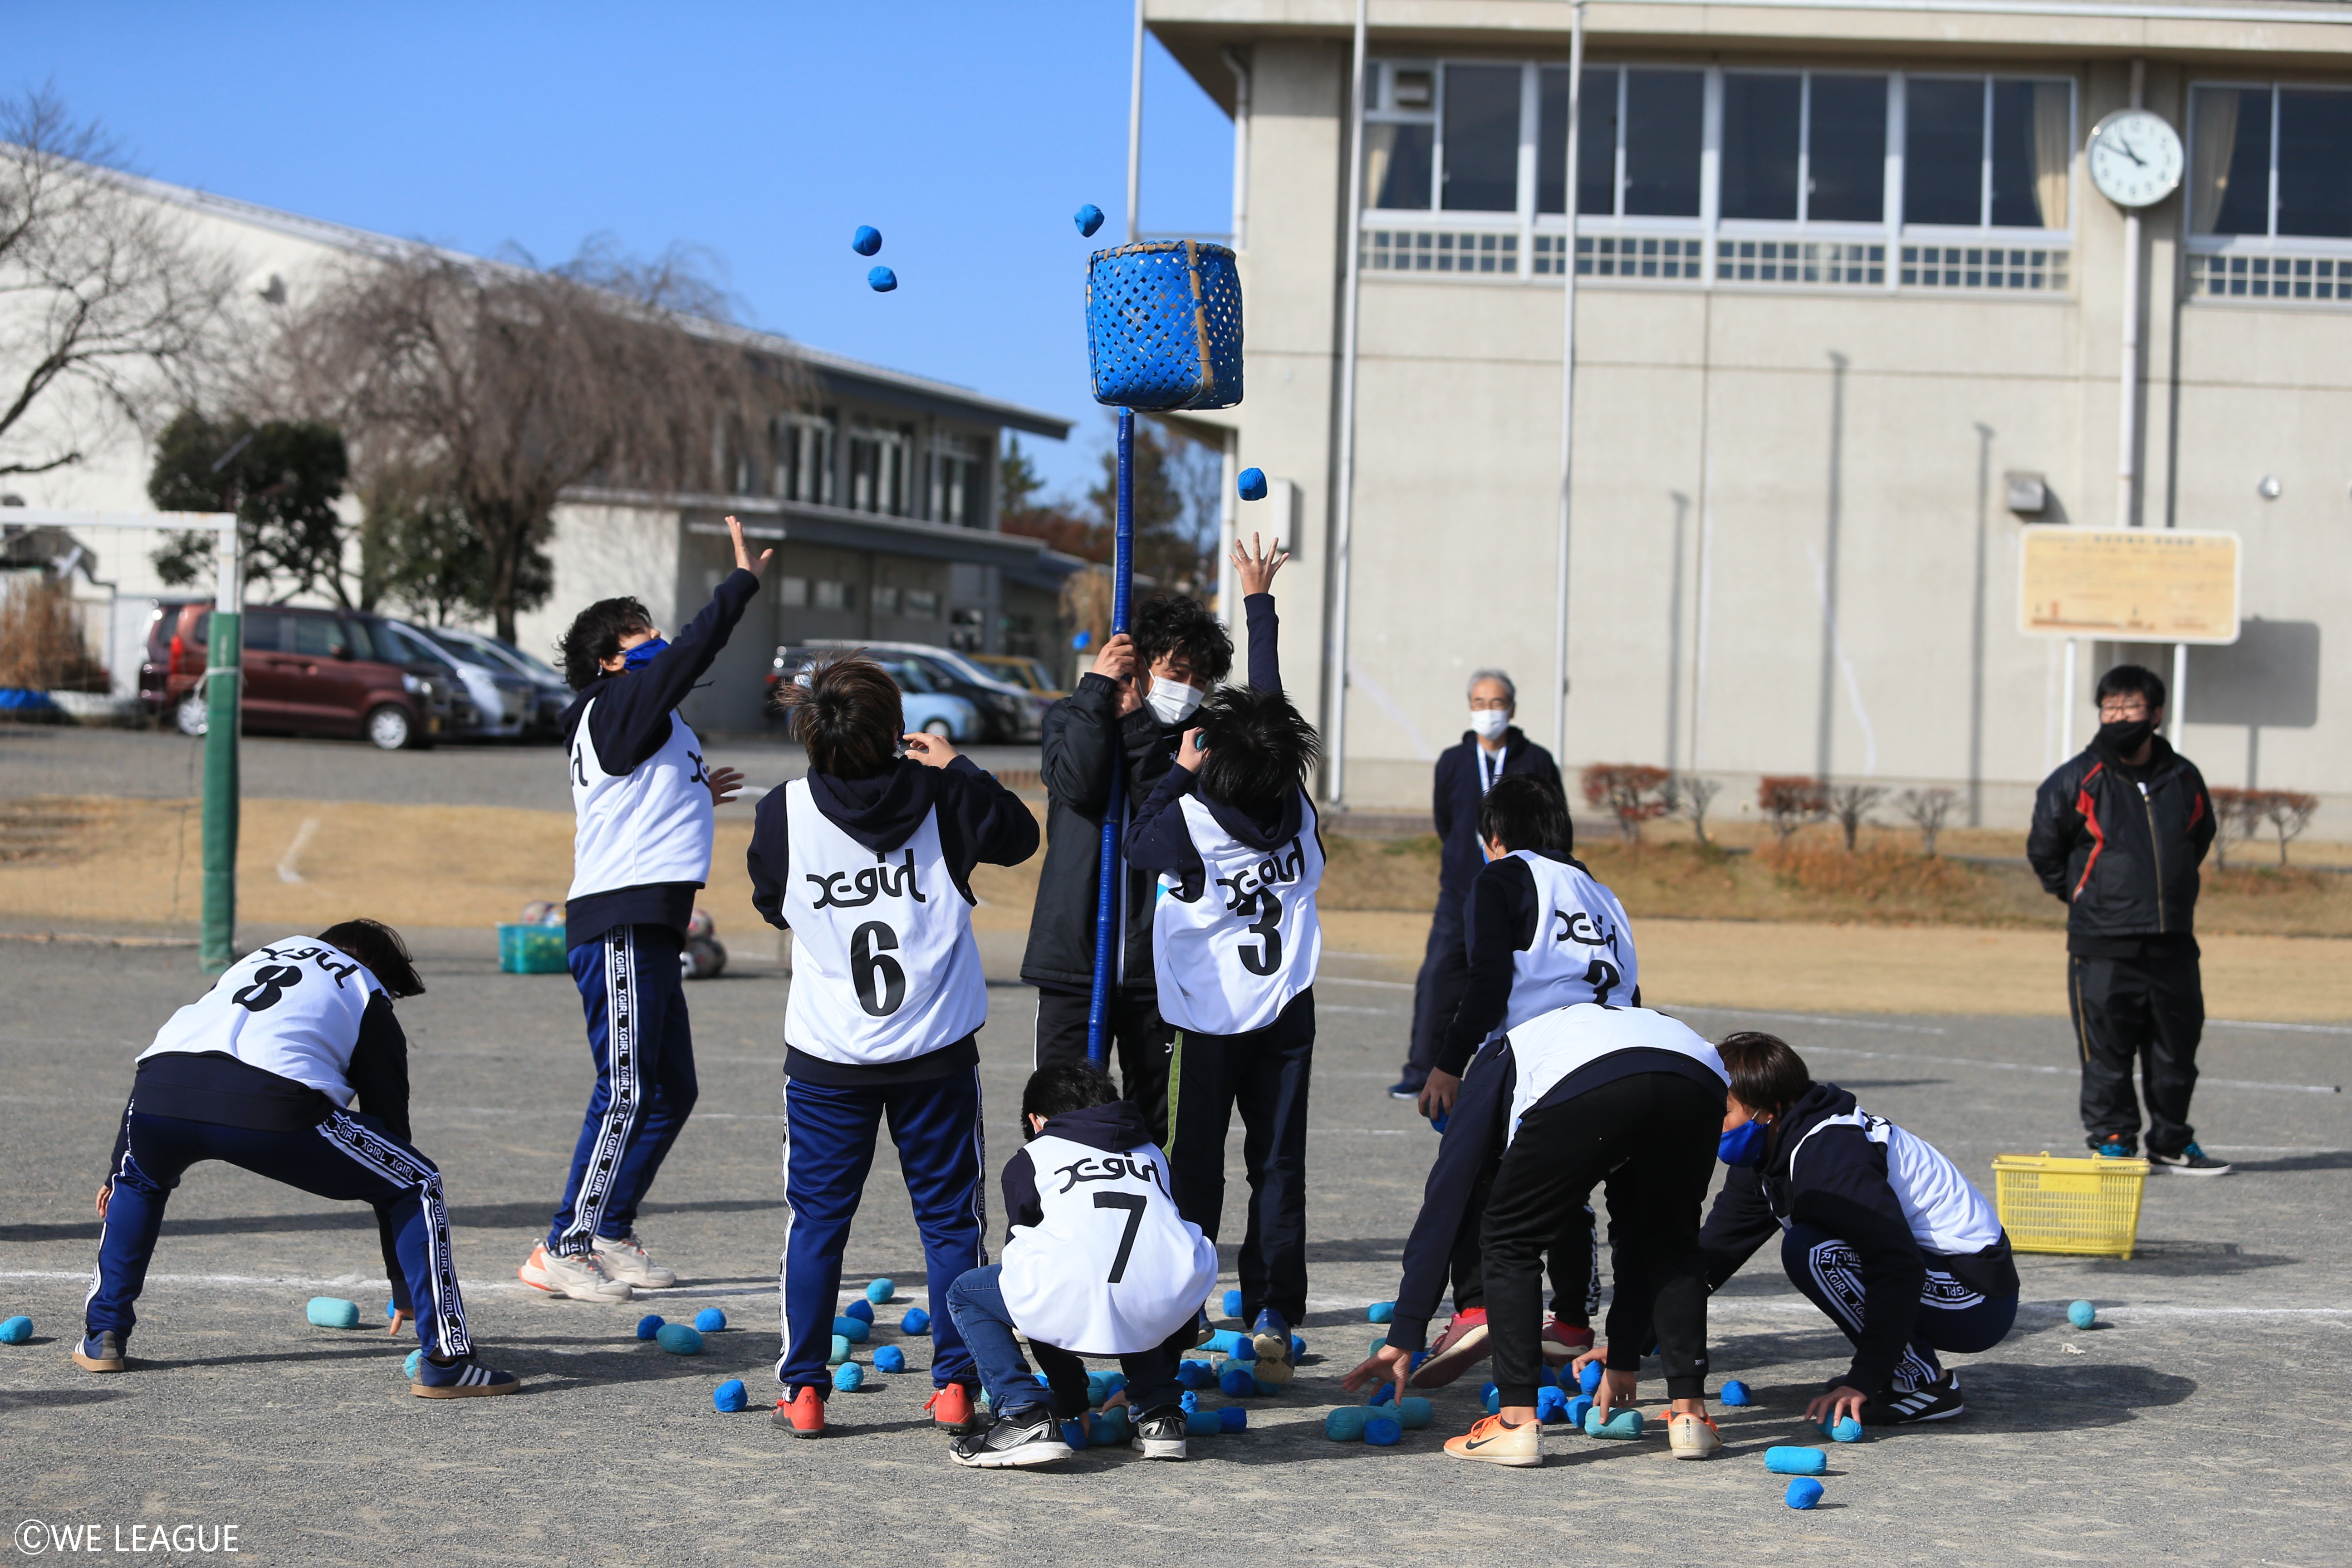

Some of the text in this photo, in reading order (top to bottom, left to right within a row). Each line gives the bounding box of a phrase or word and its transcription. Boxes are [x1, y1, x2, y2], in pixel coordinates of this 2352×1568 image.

[1237, 887, 1282, 976] 3
[615, 950, 626, 981] XGIRL
[851, 921, 906, 1017] 6
[232, 965, 302, 1011] 8
[617, 988, 627, 1019] XGIRL
[618, 1026, 629, 1057] XGIRL
[620, 1065, 630, 1093] XGIRL
[613, 1097, 630, 1125] XGIRL
[602, 1132, 619, 1161] XGIRL
[590, 1168, 608, 1197] XGIRL
[362, 1139, 385, 1161] XGIRL
[390, 1158, 413, 1180] XGIRL
[434, 1198, 445, 1231] XGIRL
[440, 1241, 448, 1275] XGIRL
[444, 1285, 454, 1318] XGIRL
[580, 1204, 595, 1232] XGIRL
[1093, 1191, 1147, 1283] 7
[1825, 1268, 1850, 1298] XGIRL
